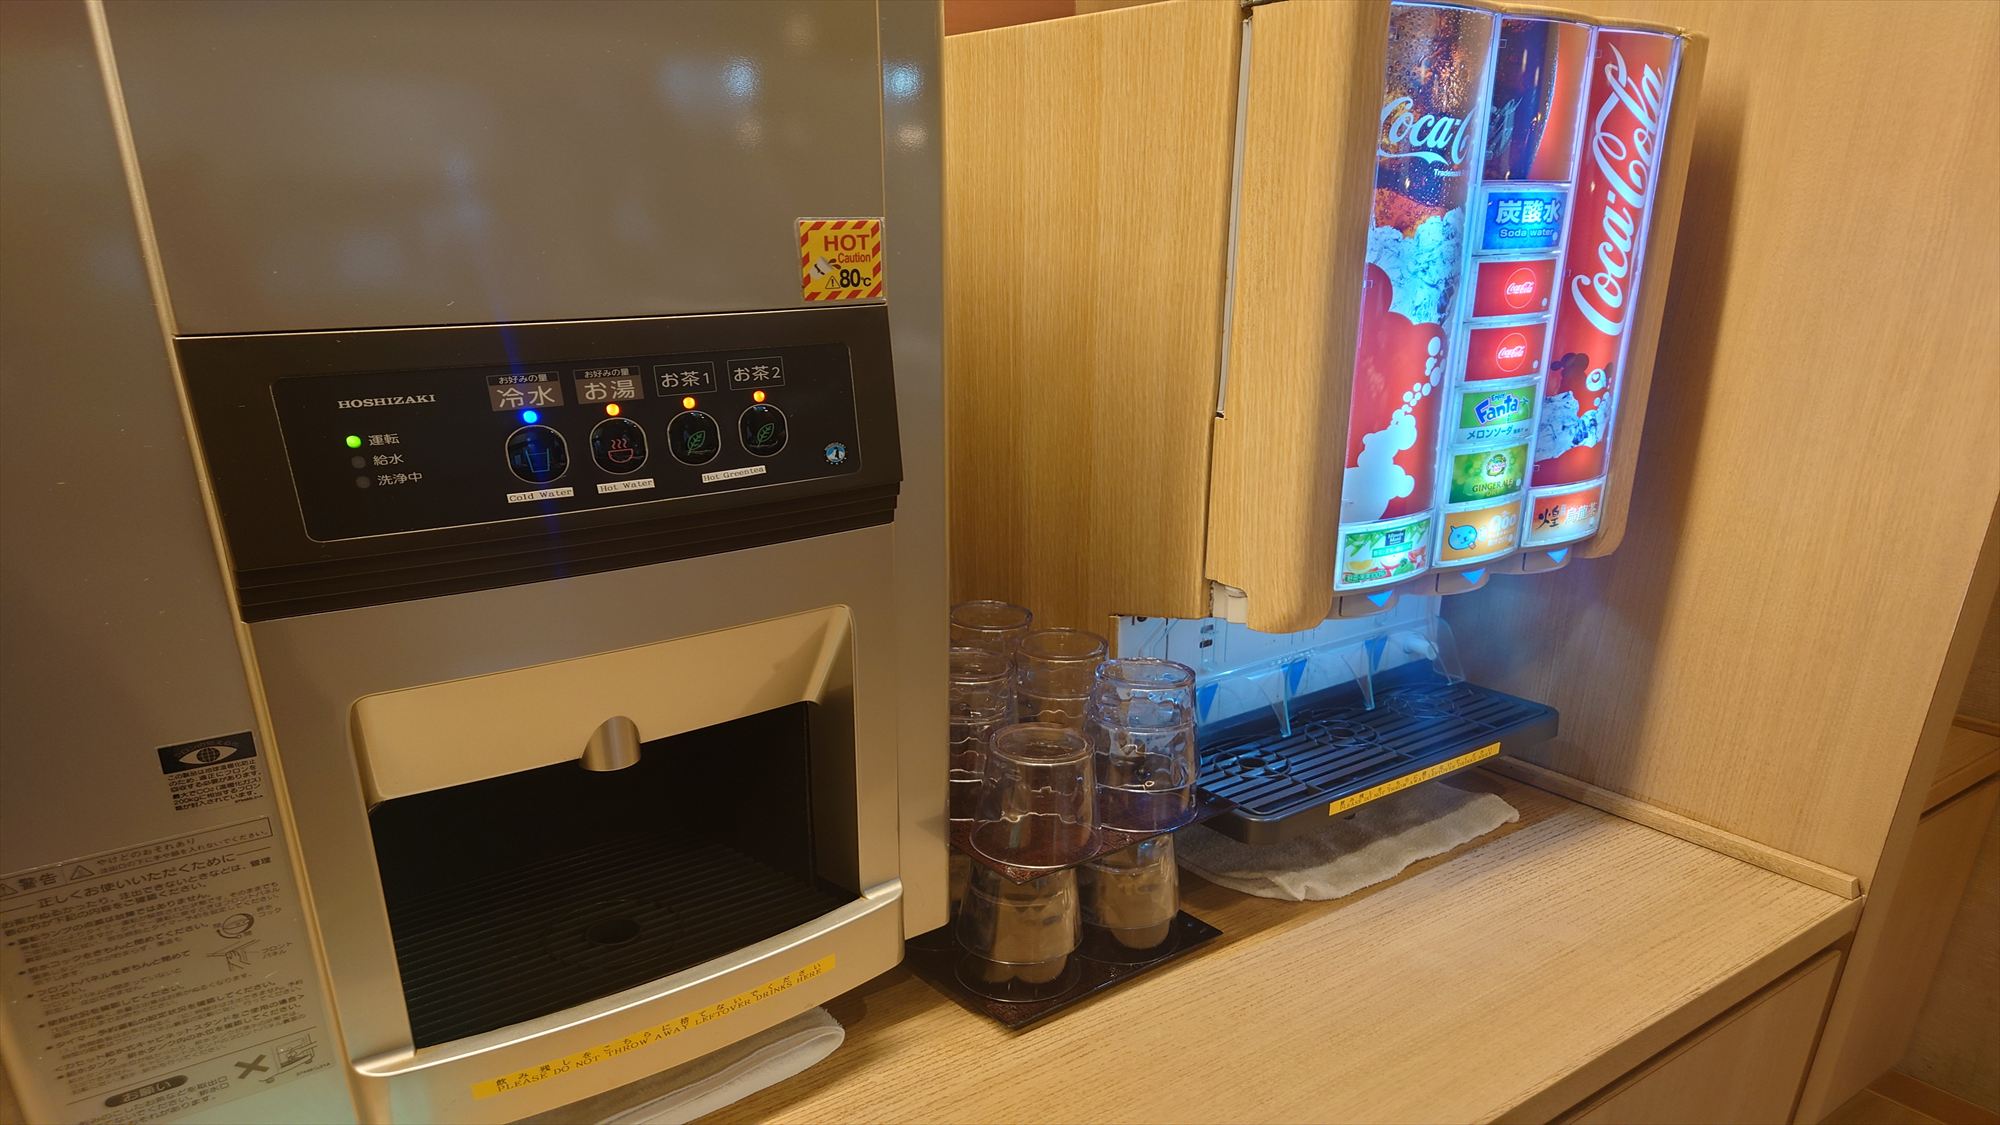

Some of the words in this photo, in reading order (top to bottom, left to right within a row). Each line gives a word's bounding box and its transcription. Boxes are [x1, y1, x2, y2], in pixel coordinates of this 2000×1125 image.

[1571, 42, 1663, 336] Coca-Cola
[1496, 199, 1561, 224] 炭酸水
[1500, 228, 1526, 238] Soda
[1530, 228, 1554, 238] water
[824, 234, 869, 251] HOT
[838, 253, 870, 263] Caution
[1506, 281, 1535, 295] Coca-Cola
[498, 373, 549, 385] お好みの量
[584, 367, 629, 379] お好みの量
[661, 371, 711, 388] お茶1
[733, 365, 781, 382] お茶2
[497, 386, 556, 408] 冷水
[584, 379, 635, 401] お湯
[337, 394, 437, 409] HOSHIZAKI
[1474, 395, 1520, 425] Fanta
[368, 433, 400, 447] 運転
[1467, 426, 1514, 440] メロンソーダ
[373, 454, 405, 467] 給水
[377, 471, 423, 487] 洗浄中
[703, 472, 720, 482] Hot
[723, 465, 764, 480] Greentea
[600, 483, 618, 493] Hot
[624, 479, 653, 490] Water
[1472, 480, 1501, 494] GINGER
[509, 491, 534, 502] Cold
[539, 488, 572, 499] Water
[37, 852, 237, 908] 正しくお使いいただくために
[498, 1072, 549, 1092] PLEASE
[554, 1065, 571, 1076] DO
[575, 1054, 601, 1068] NOT
[607, 1037, 650, 1057] THROW
[655, 1023, 689, 1041] AWAY
[695, 1000, 751, 1026] LEFTOVER
[755, 981, 793, 1001] DRINKS
[797, 967, 823, 984] HERE
